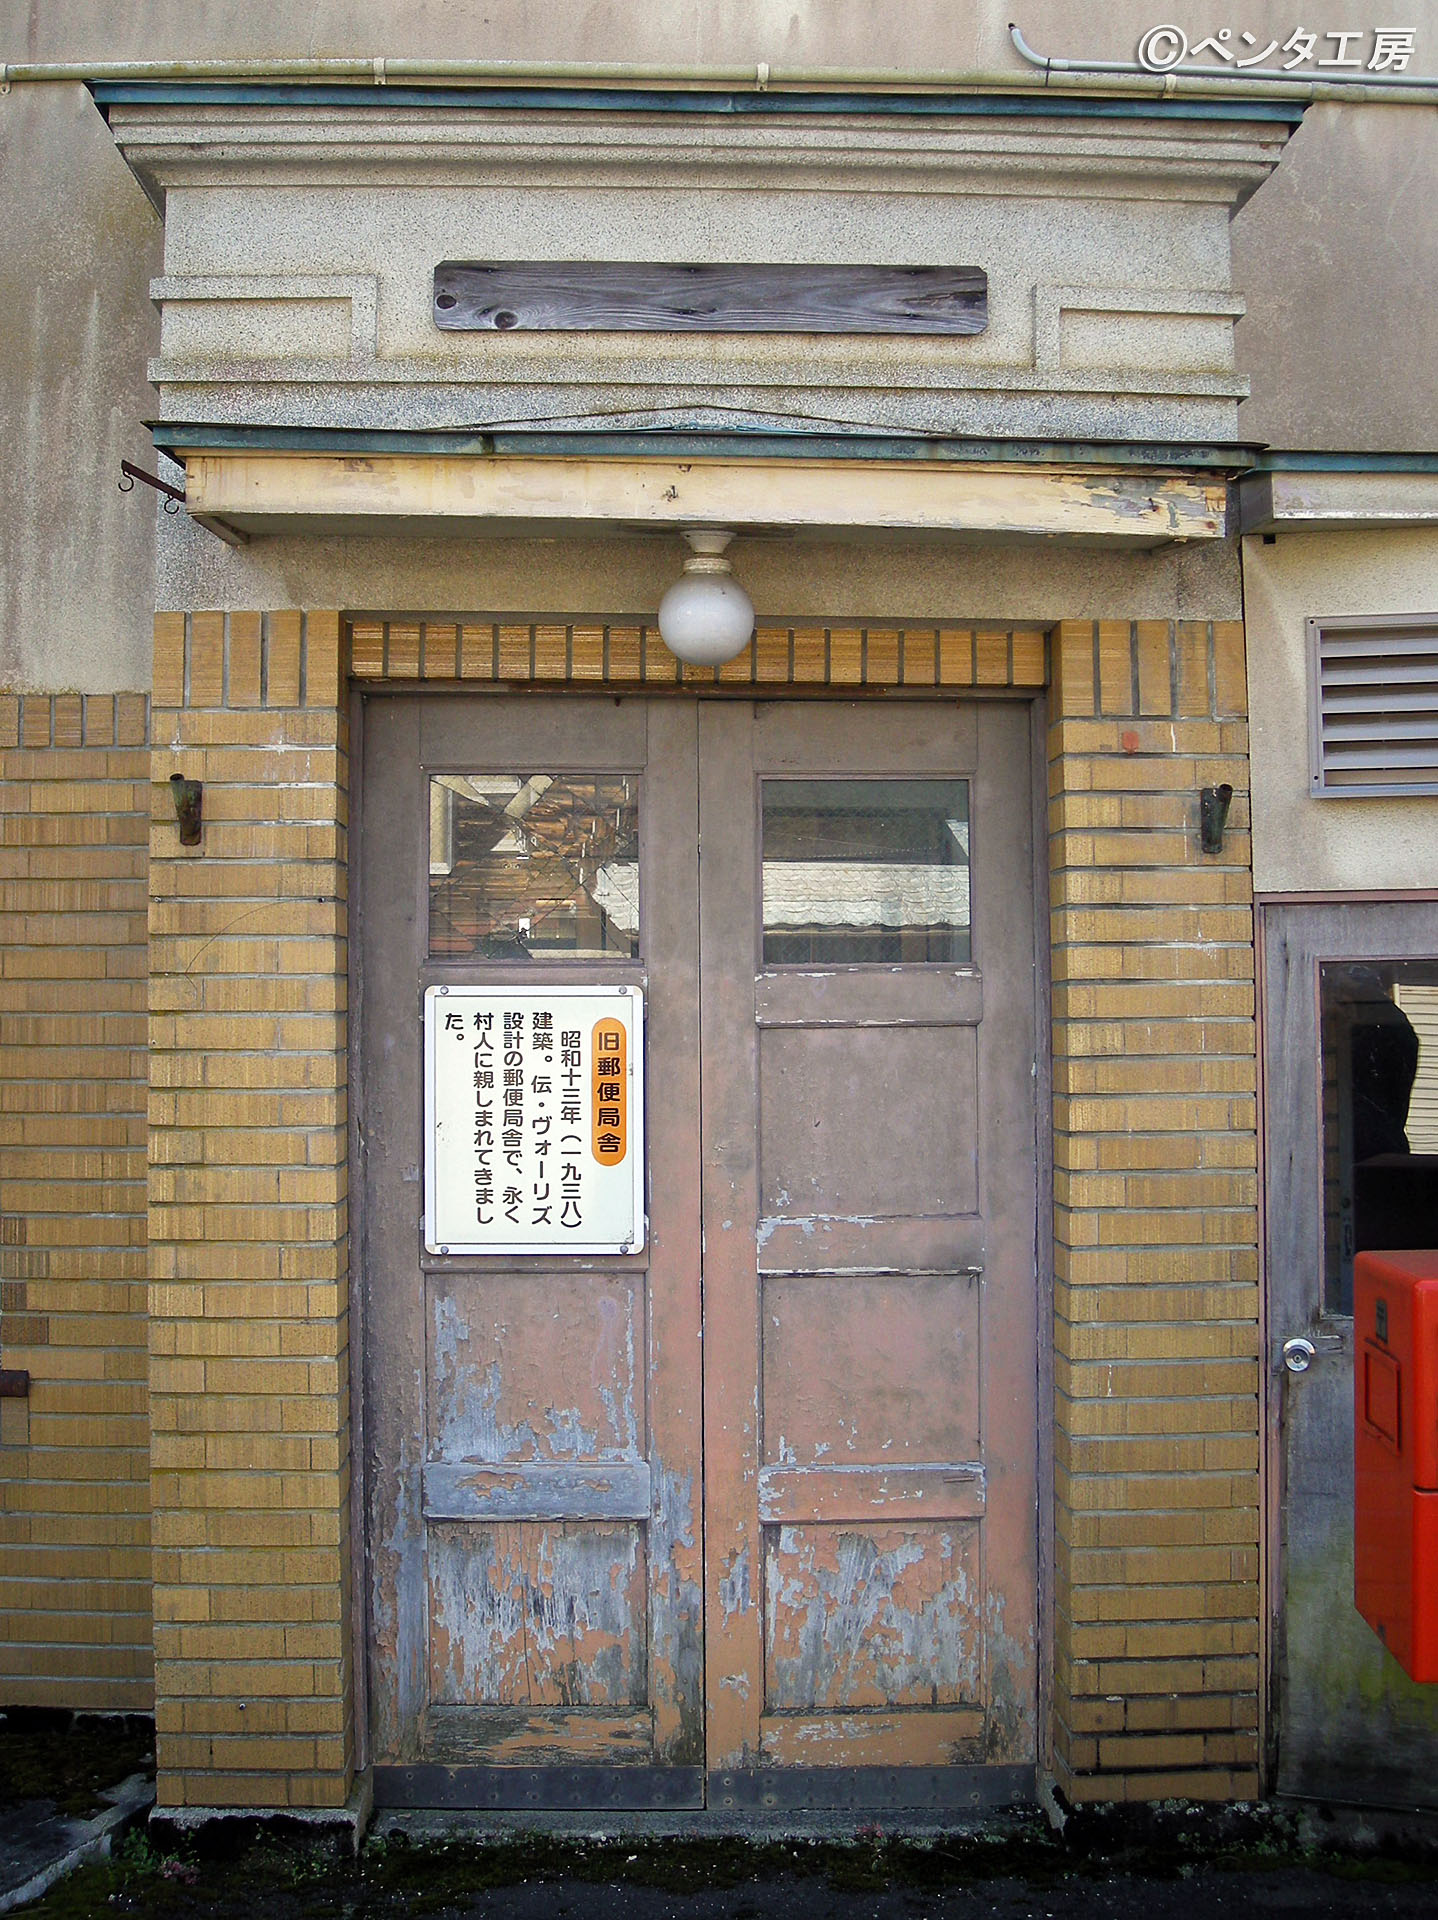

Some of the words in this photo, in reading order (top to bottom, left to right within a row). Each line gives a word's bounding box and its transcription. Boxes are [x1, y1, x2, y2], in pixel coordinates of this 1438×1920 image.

[444, 1012, 465, 1041] た。
[473, 1011, 495, 1225] 村人に親しまれてきまし
[597, 1031, 621, 1153] 旧郵便局舎
